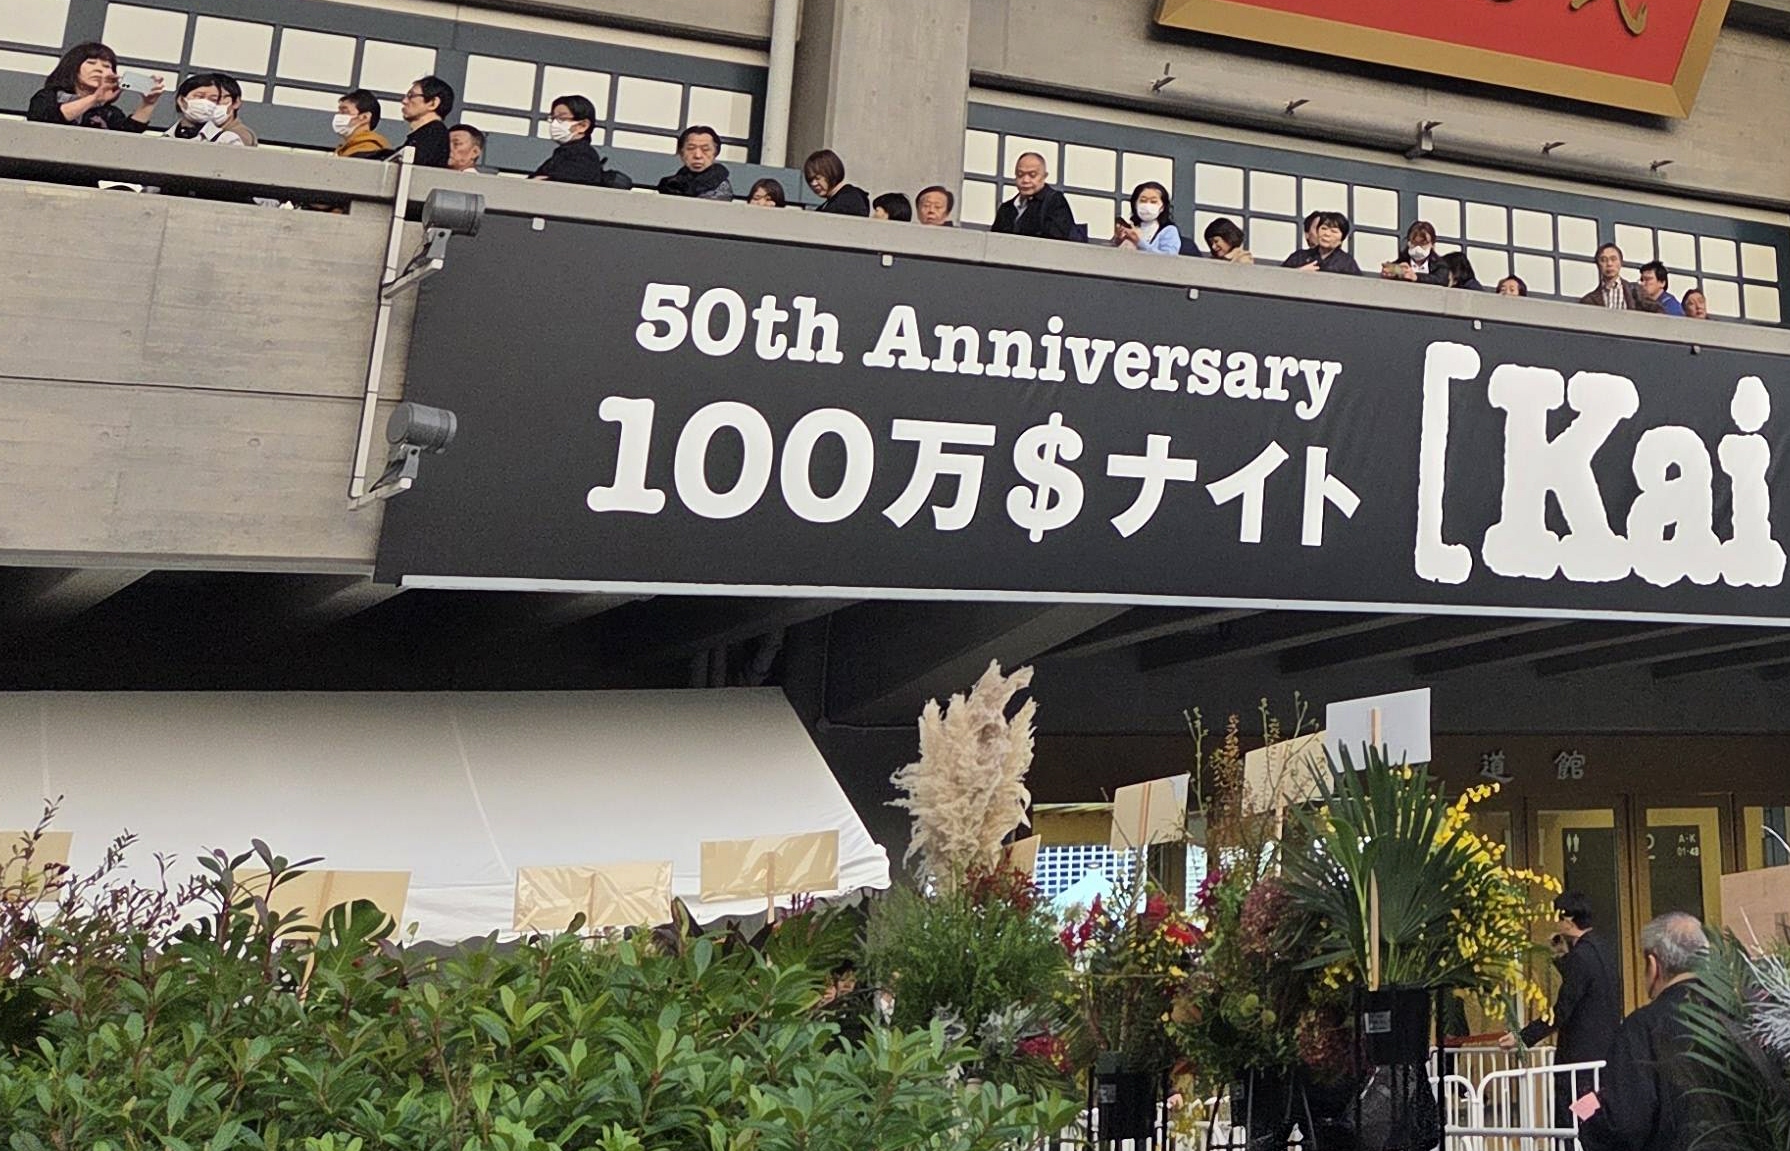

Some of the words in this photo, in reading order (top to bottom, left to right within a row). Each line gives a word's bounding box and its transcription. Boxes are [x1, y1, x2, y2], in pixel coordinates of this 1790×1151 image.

[635, 282, 844, 364] 50th
[862, 305, 1343, 421] Anniversary
[586, 395, 1361, 547] 100万$ナイト
